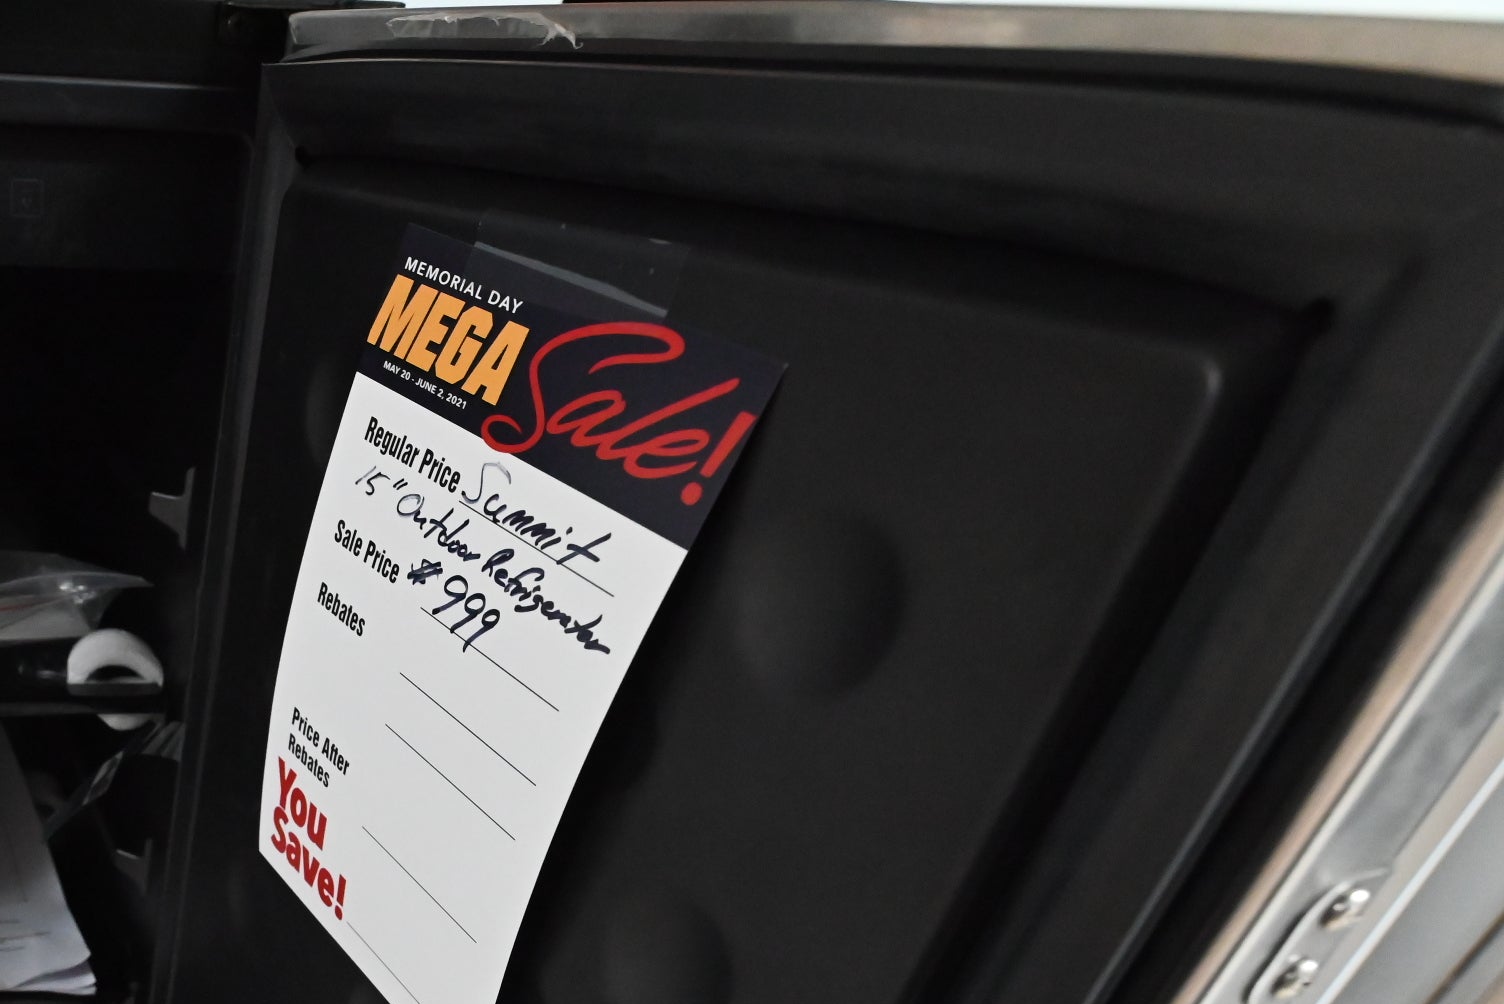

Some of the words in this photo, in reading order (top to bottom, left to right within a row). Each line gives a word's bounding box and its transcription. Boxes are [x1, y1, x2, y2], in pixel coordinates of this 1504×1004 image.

[404, 256, 483, 301] MEMORIAL
[488, 289, 524, 315] DAY
[366, 274, 530, 406] MEGA
[383, 360, 401, 375] MAY
[401, 369, 411, 381] 20
[415, 377, 438, 395] JUNE
[437, 388, 444, 400] 2,
[446, 393, 467, 409] 2021
[481, 321, 757, 506] Sale!
[364, 416, 420, 468] Regular
[417, 448, 462, 494] Price
[461, 461, 612, 565] Summit
[334, 519, 367, 559] Sale
[365, 543, 401, 585] Price
[316, 581, 366, 638] Rebates
[287, 732, 330, 788] Rebates
[291, 706, 320, 748] Price
[320, 736, 350, 776] After
[278, 755, 327, 851] You
[270, 805, 347, 921] Save!
